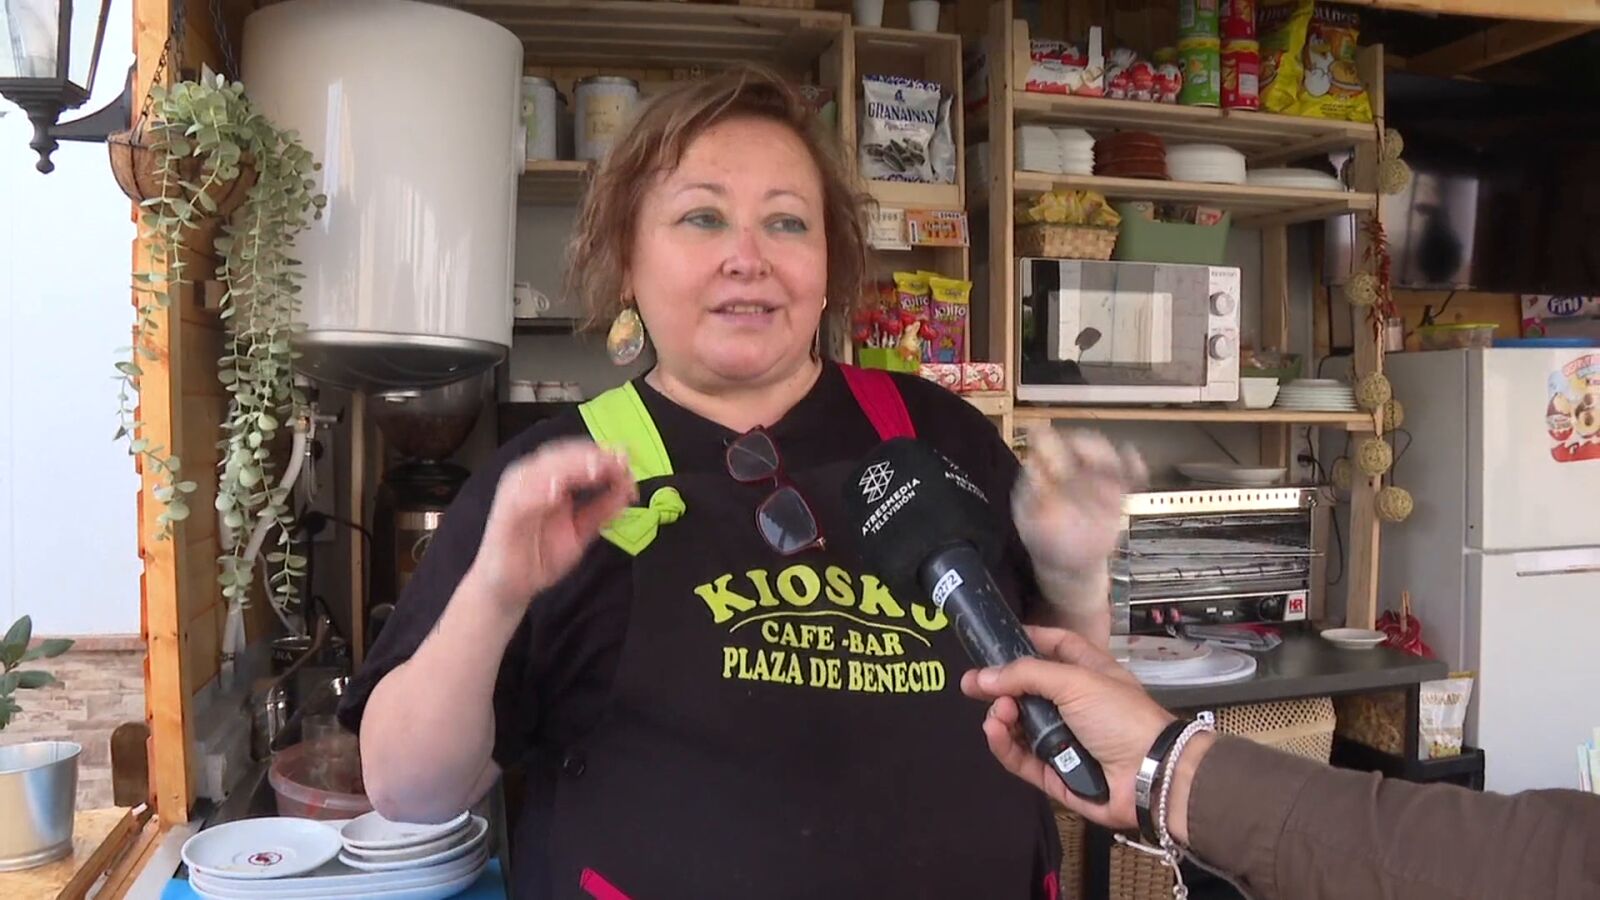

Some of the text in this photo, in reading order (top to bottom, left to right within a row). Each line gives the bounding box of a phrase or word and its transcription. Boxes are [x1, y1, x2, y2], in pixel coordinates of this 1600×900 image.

[861, 478, 920, 536] ATRESMEDIA
[761, 620, 835, 650] CAFE
[723, 647, 946, 693] PLAZA DE BENECID
